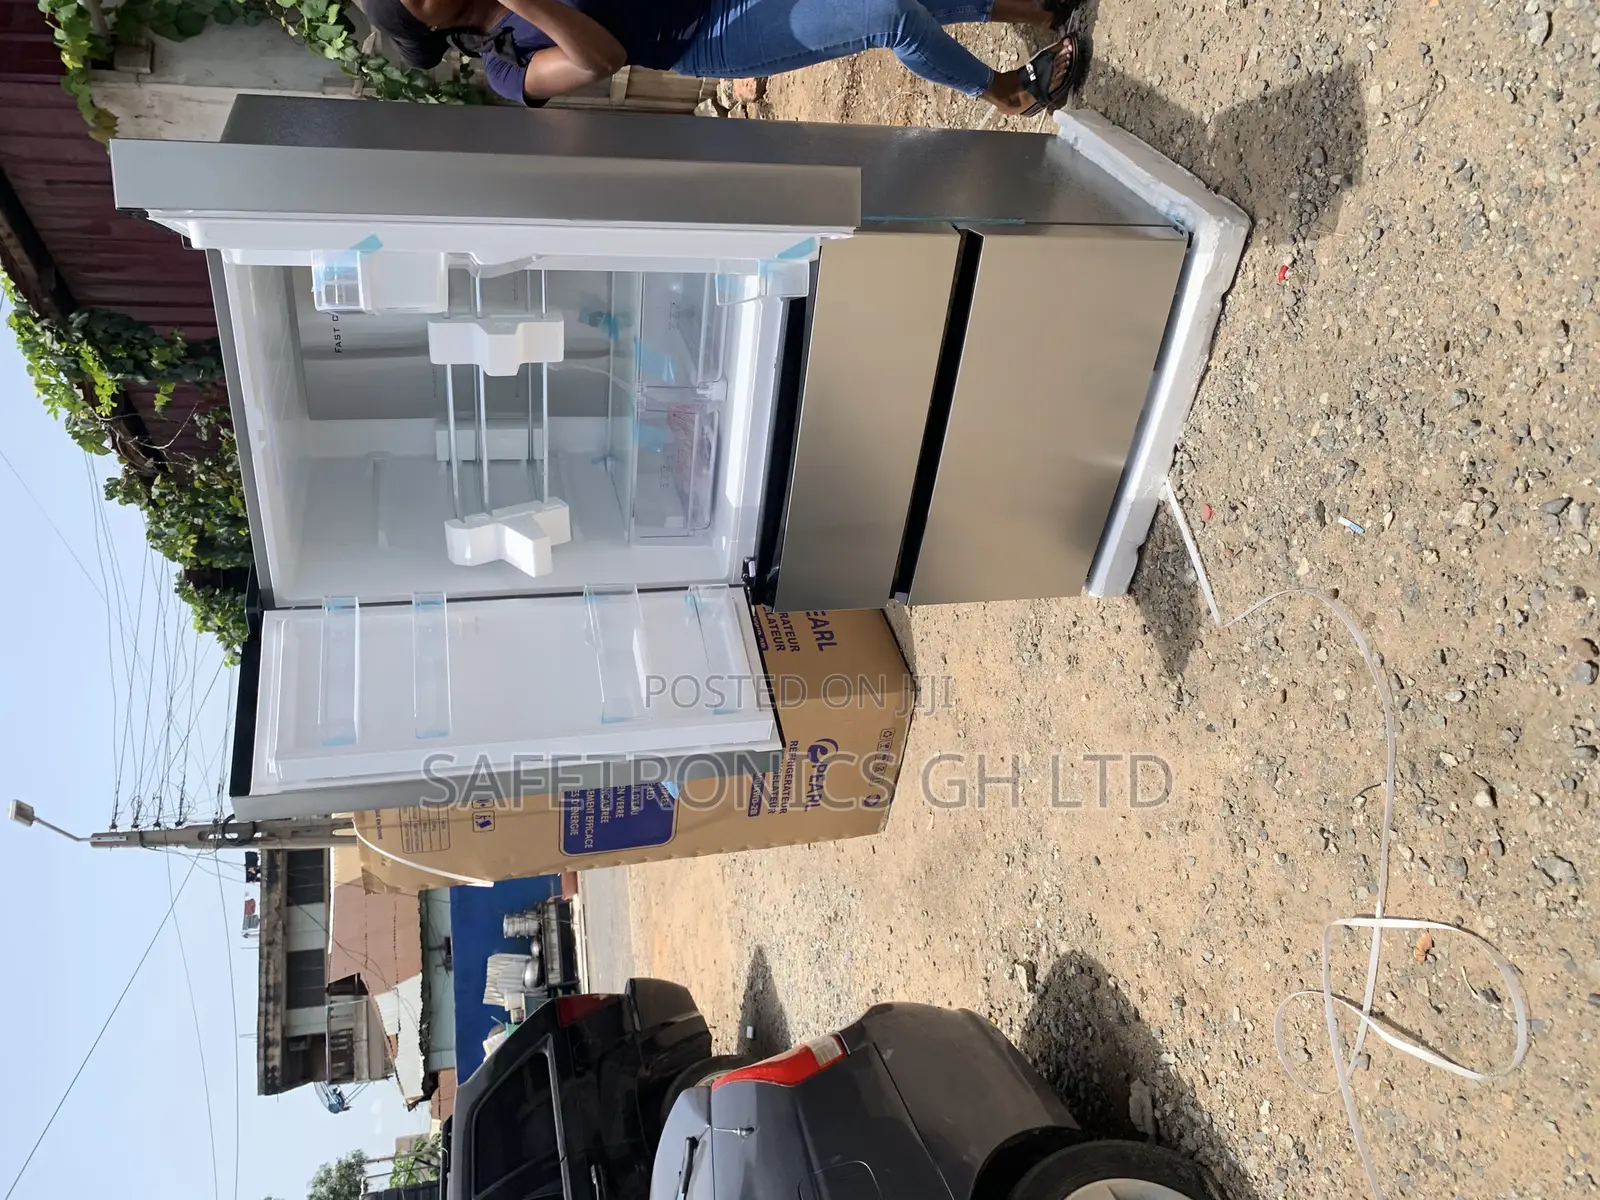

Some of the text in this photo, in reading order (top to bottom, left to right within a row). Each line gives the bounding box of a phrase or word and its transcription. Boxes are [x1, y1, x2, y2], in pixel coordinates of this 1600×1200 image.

[333, 327, 342, 353] FAST
[615, 793, 625, 818] VERRE
[804, 763, 828, 812] PEARL
[584, 788, 595, 849] EMENT EFFICACE
